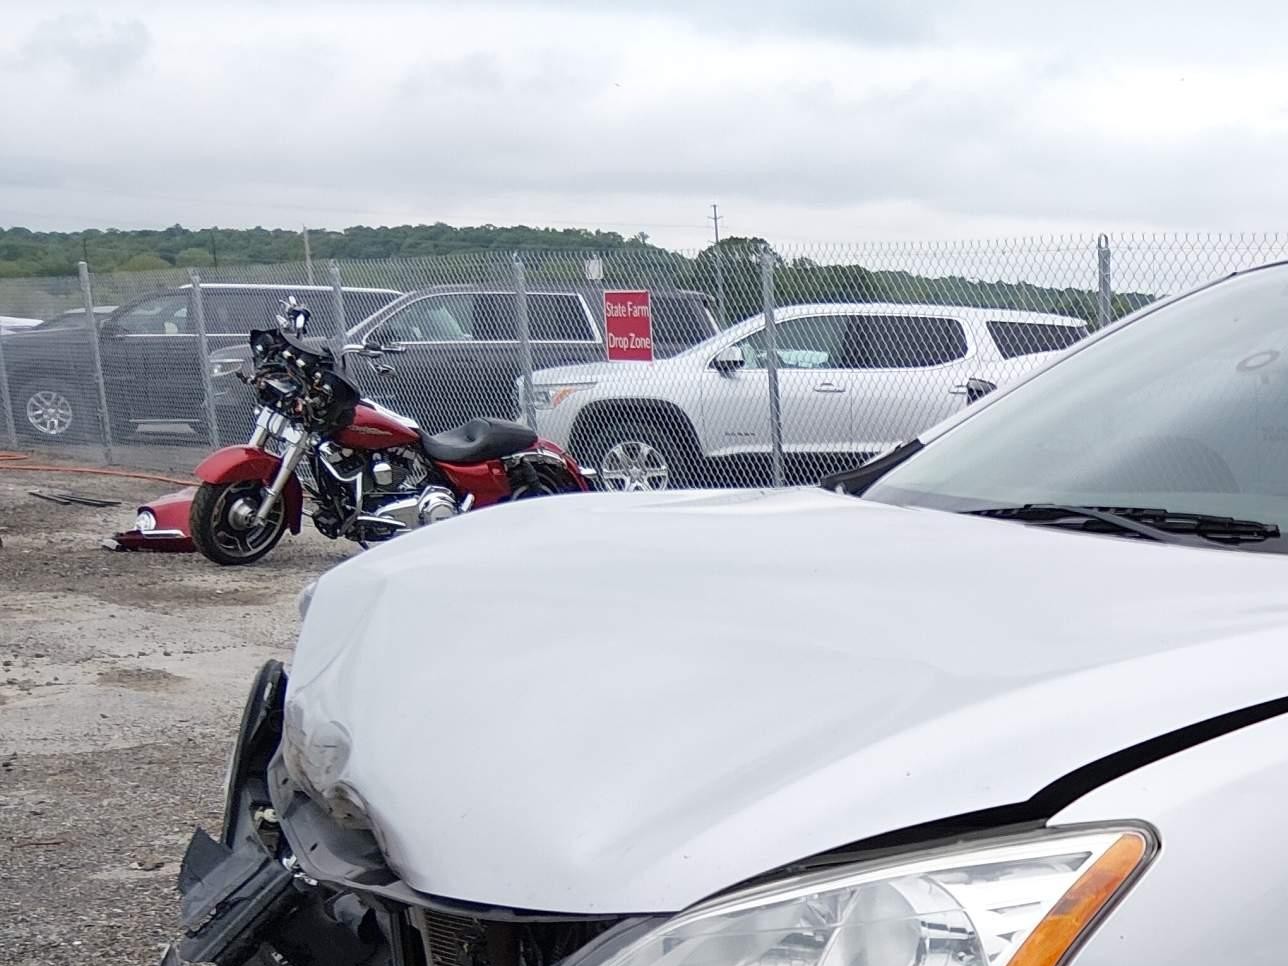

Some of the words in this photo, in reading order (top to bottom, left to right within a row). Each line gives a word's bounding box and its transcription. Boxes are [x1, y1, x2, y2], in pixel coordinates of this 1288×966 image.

[606, 302, 626, 317] State
[627, 302, 649, 317] Farm
[608, 333, 629, 351] Drop
[629, 333, 651, 349] Zone
